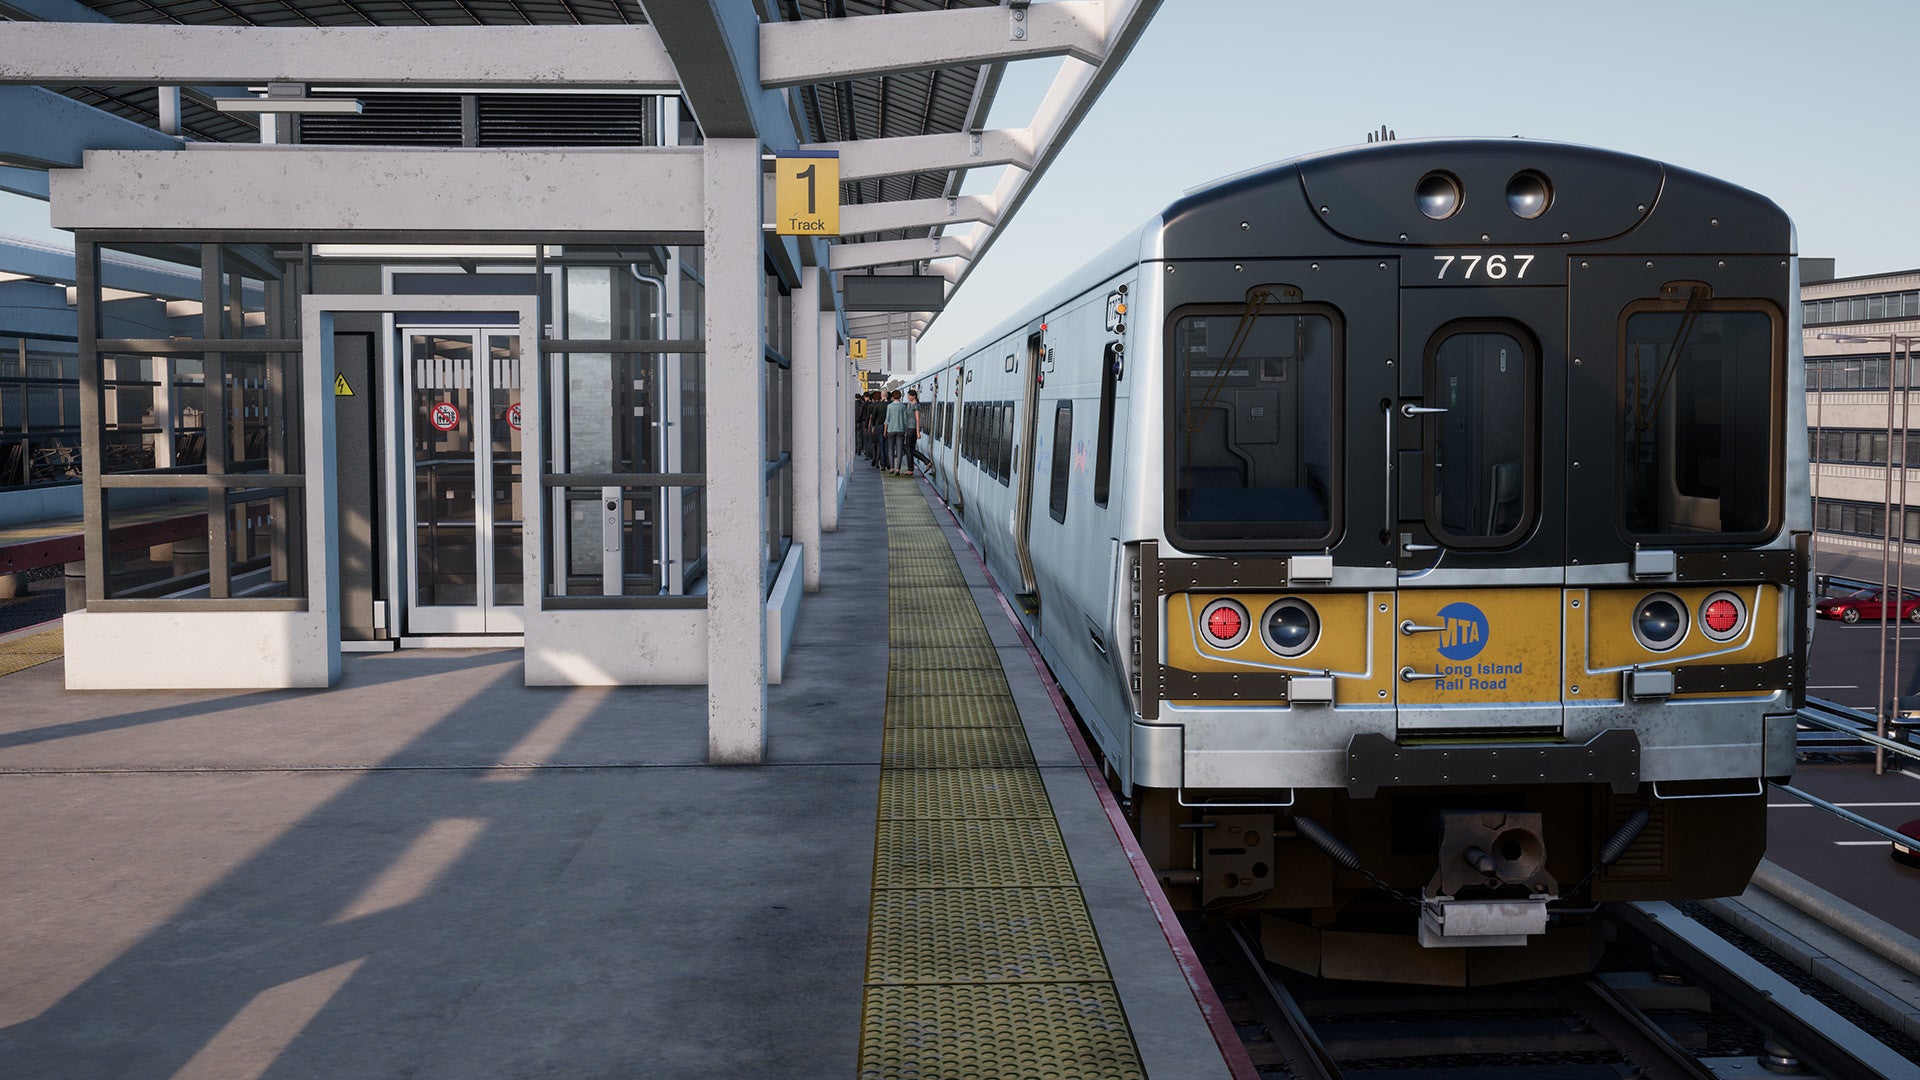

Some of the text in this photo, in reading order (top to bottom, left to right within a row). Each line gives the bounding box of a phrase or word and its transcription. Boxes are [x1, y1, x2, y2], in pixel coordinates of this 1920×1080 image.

[796, 164, 816, 214] 1
[789, 218, 826, 231] Track
[1434, 254, 1535, 279] 7767
[855, 340, 860, 353] 1
[1437, 615, 1480, 649] MTA
[1435, 662, 1523, 678] Long Island
[1435, 678, 1507, 691] Rail Road
